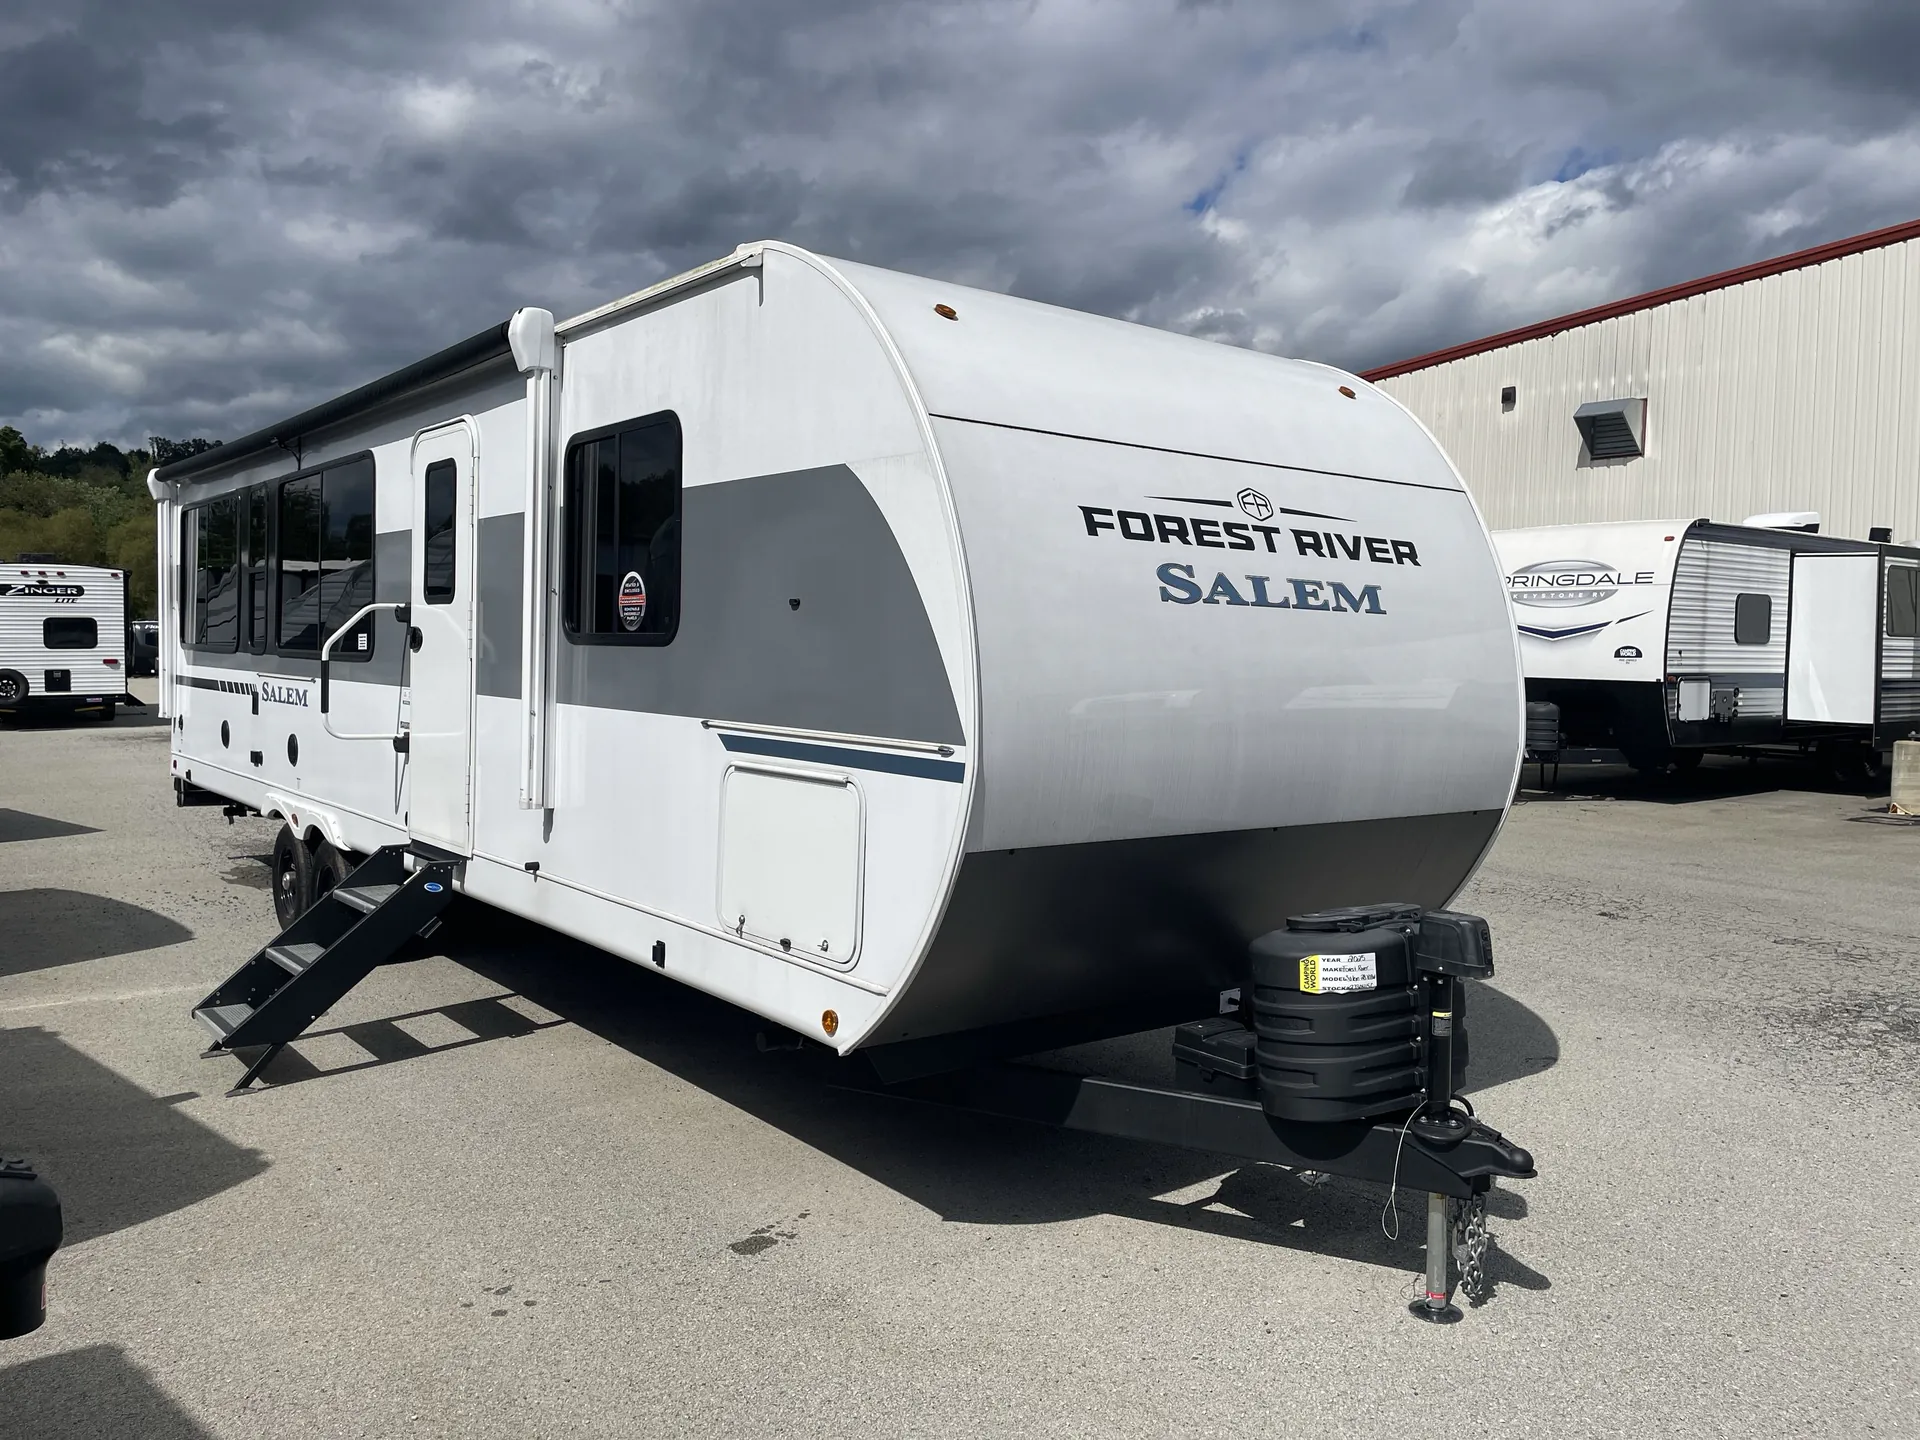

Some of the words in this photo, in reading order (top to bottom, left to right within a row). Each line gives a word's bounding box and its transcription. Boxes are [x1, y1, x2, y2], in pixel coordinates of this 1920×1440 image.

[1077, 505, 1281, 553] FOREST
[1289, 528, 1422, 567] RIVER
[5, 584, 78, 596] ZINGER
[1155, 562, 1388, 615] SALEM
[1506, 571, 1655, 588] RINGDALE
[261, 681, 309, 707] SALEM
